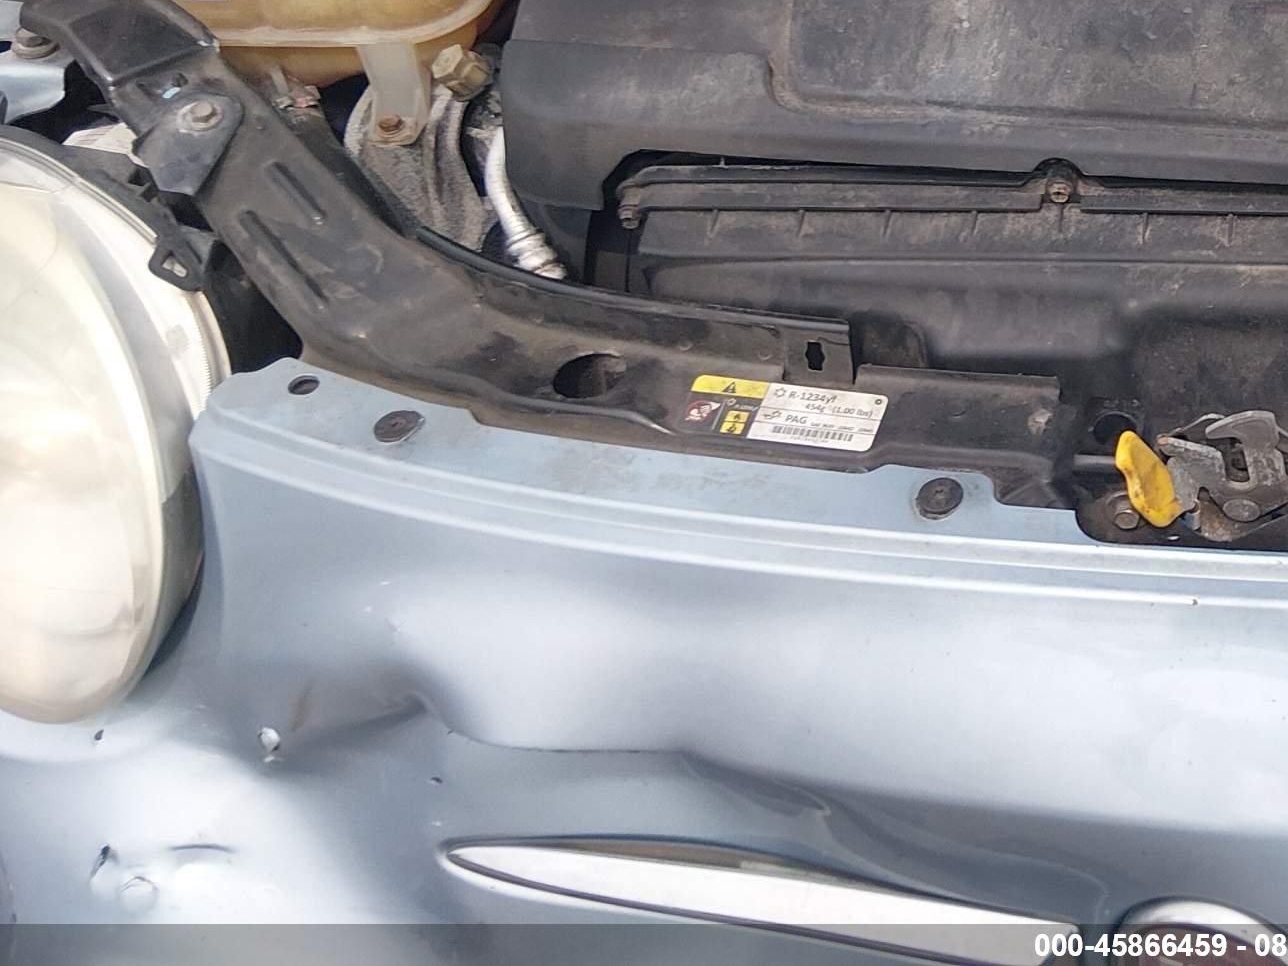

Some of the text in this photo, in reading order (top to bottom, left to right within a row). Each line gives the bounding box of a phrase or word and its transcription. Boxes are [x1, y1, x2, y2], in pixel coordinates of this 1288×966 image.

[788, 390, 838, 405] R-1234yf
[832, 405, 855, 415] (1.00
[856, 408, 874, 419] lbs)
[785, 414, 809, 425] PAG
